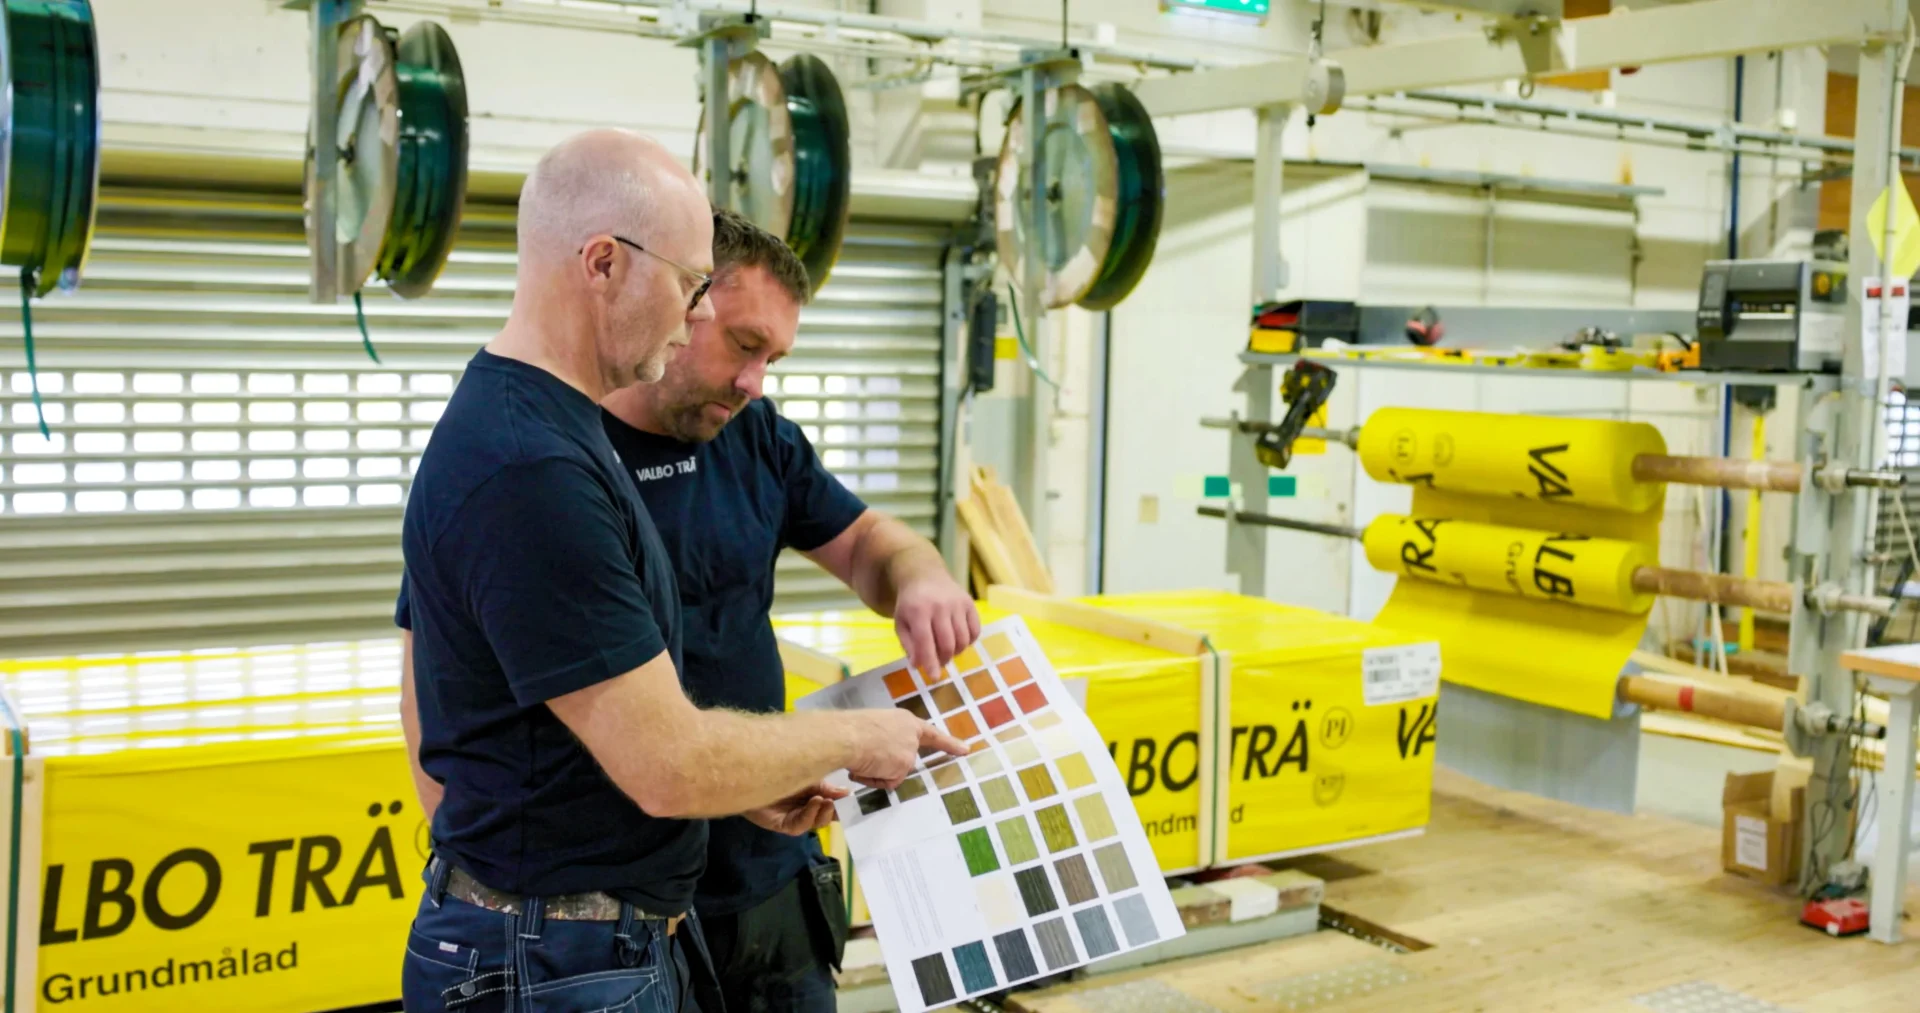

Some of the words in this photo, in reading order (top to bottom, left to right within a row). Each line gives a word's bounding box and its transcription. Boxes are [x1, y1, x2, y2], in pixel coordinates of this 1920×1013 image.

[636, 464, 674, 482] VALBO
[676, 455, 697, 475] TRÄ
[247, 800, 405, 919] TRÄ
[42, 941, 299, 1005] Grundmålad
